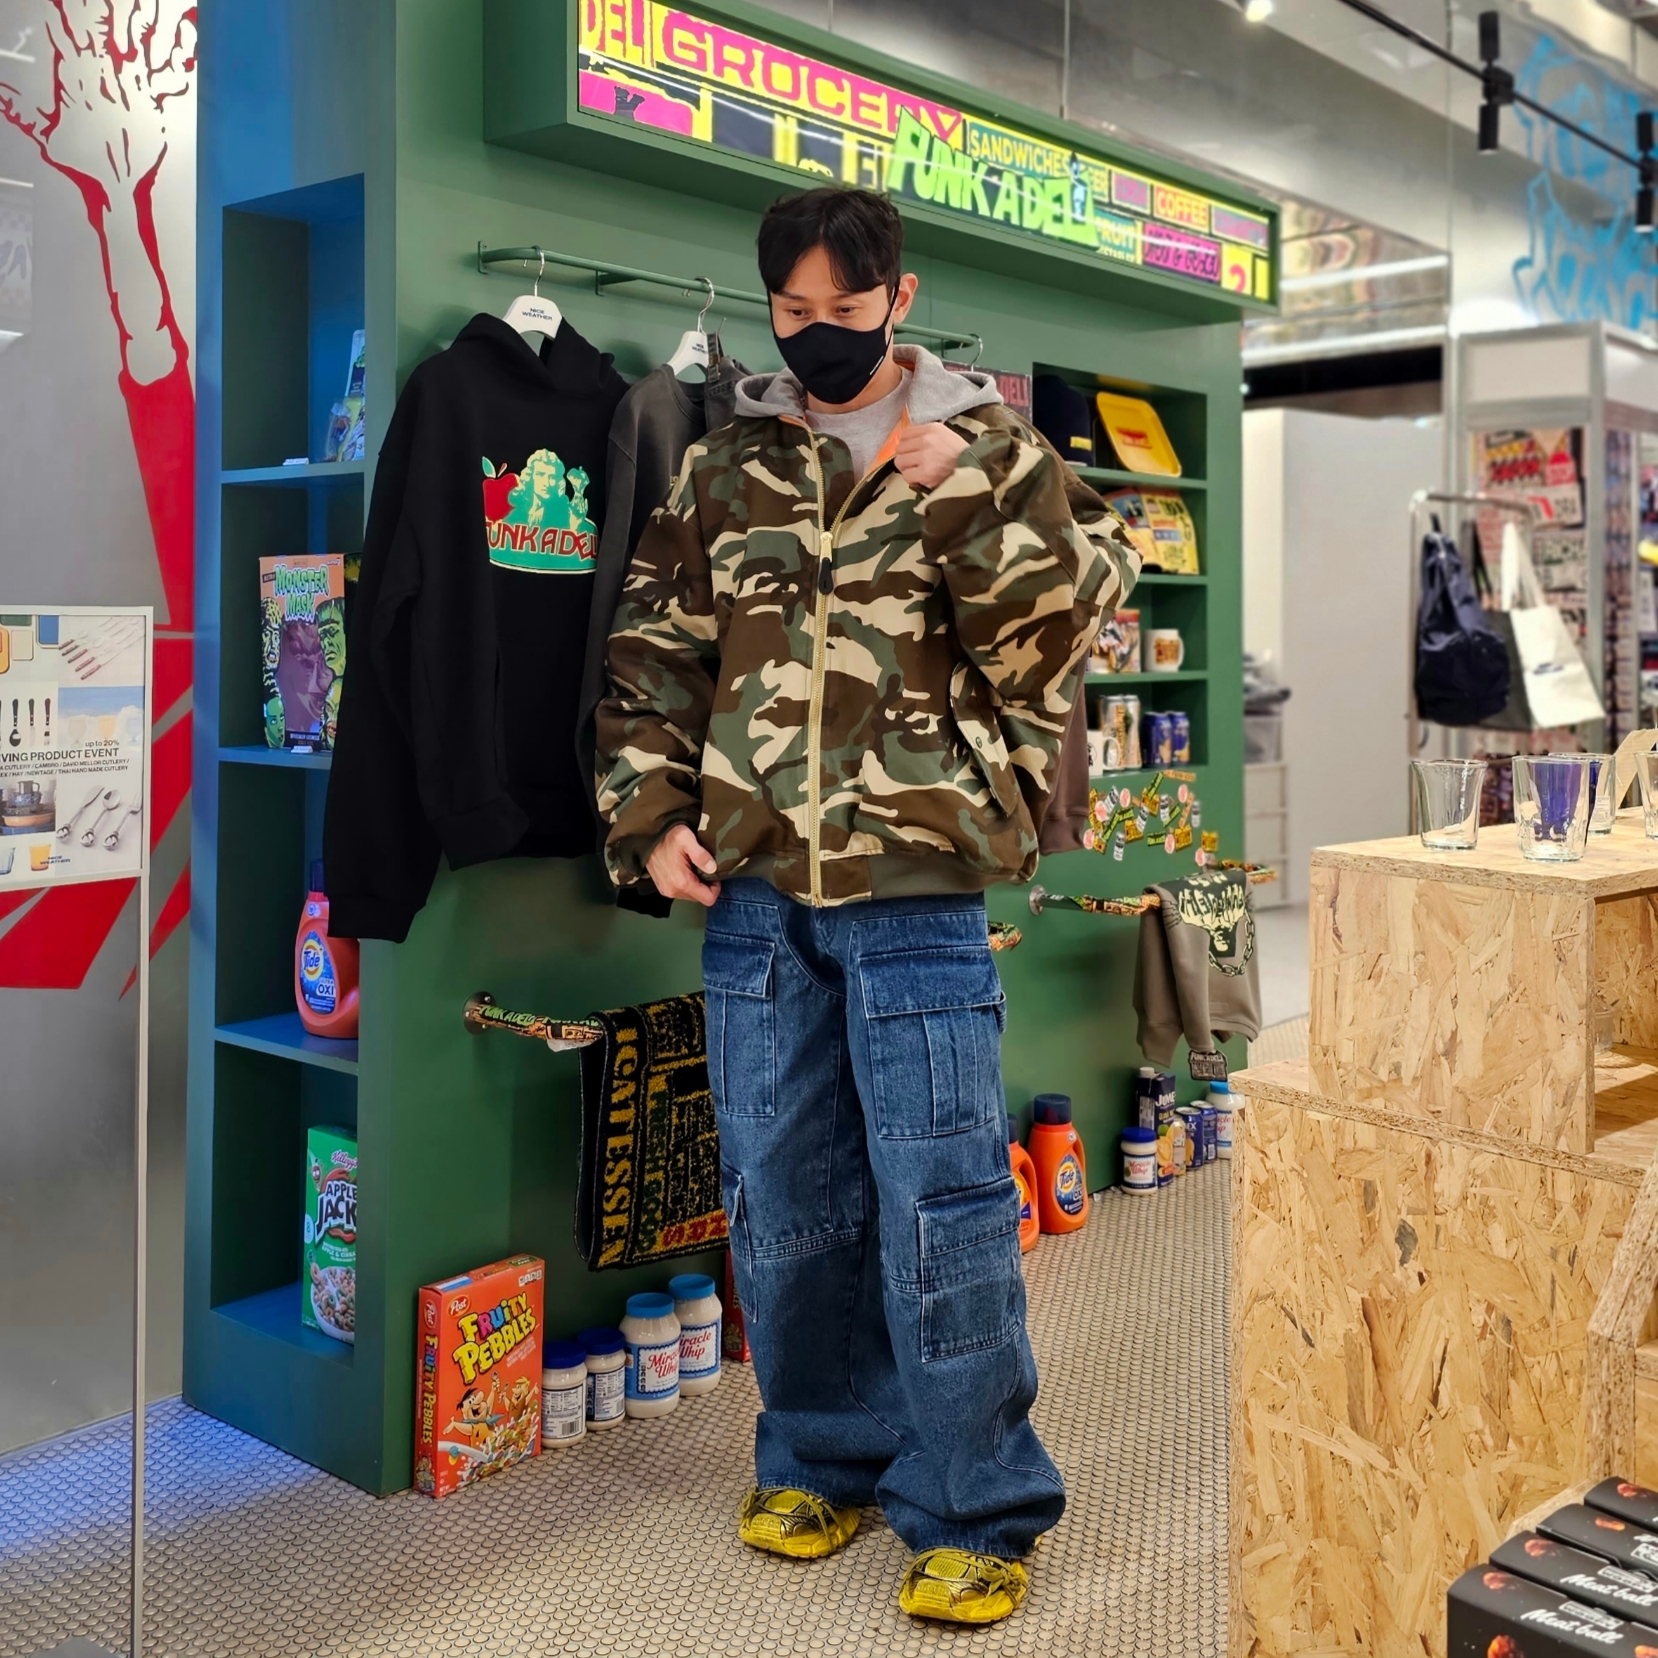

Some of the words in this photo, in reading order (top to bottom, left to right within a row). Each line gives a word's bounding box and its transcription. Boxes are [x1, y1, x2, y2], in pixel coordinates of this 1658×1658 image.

[662, 9, 963, 141] GROCERY
[968, 128, 1070, 179] SANDWICHES
[1156, 185, 1209, 230] COFFEE
[522, 311, 553, 321] WEATHER
[530, 307, 545, 315] NICE
[274, 564, 329, 597] MONSTER
[285, 593, 315, 622] MASK
[30, 750, 82, 761] PRODUCT
[84, 748, 119, 758] EVENT
[303, 950, 321, 971] Tide
[318, 984, 334, 996] OXI
[1060, 1169, 1075, 1189] Tide
[326, 1183, 358, 1201] APPLE
[450, 1299, 468, 1312] Post
[453, 1307, 537, 1386] PEBBLES
[679, 1331, 711, 1347] iracle
[422, 1392, 437, 1445] PEBBLES
[1559, 1573, 1619, 1595] Meat
[1612, 1587, 1658, 1607] ball
[1520, 1609, 1580, 1631] Meat
[1574, 1623, 1625, 1645] ball
